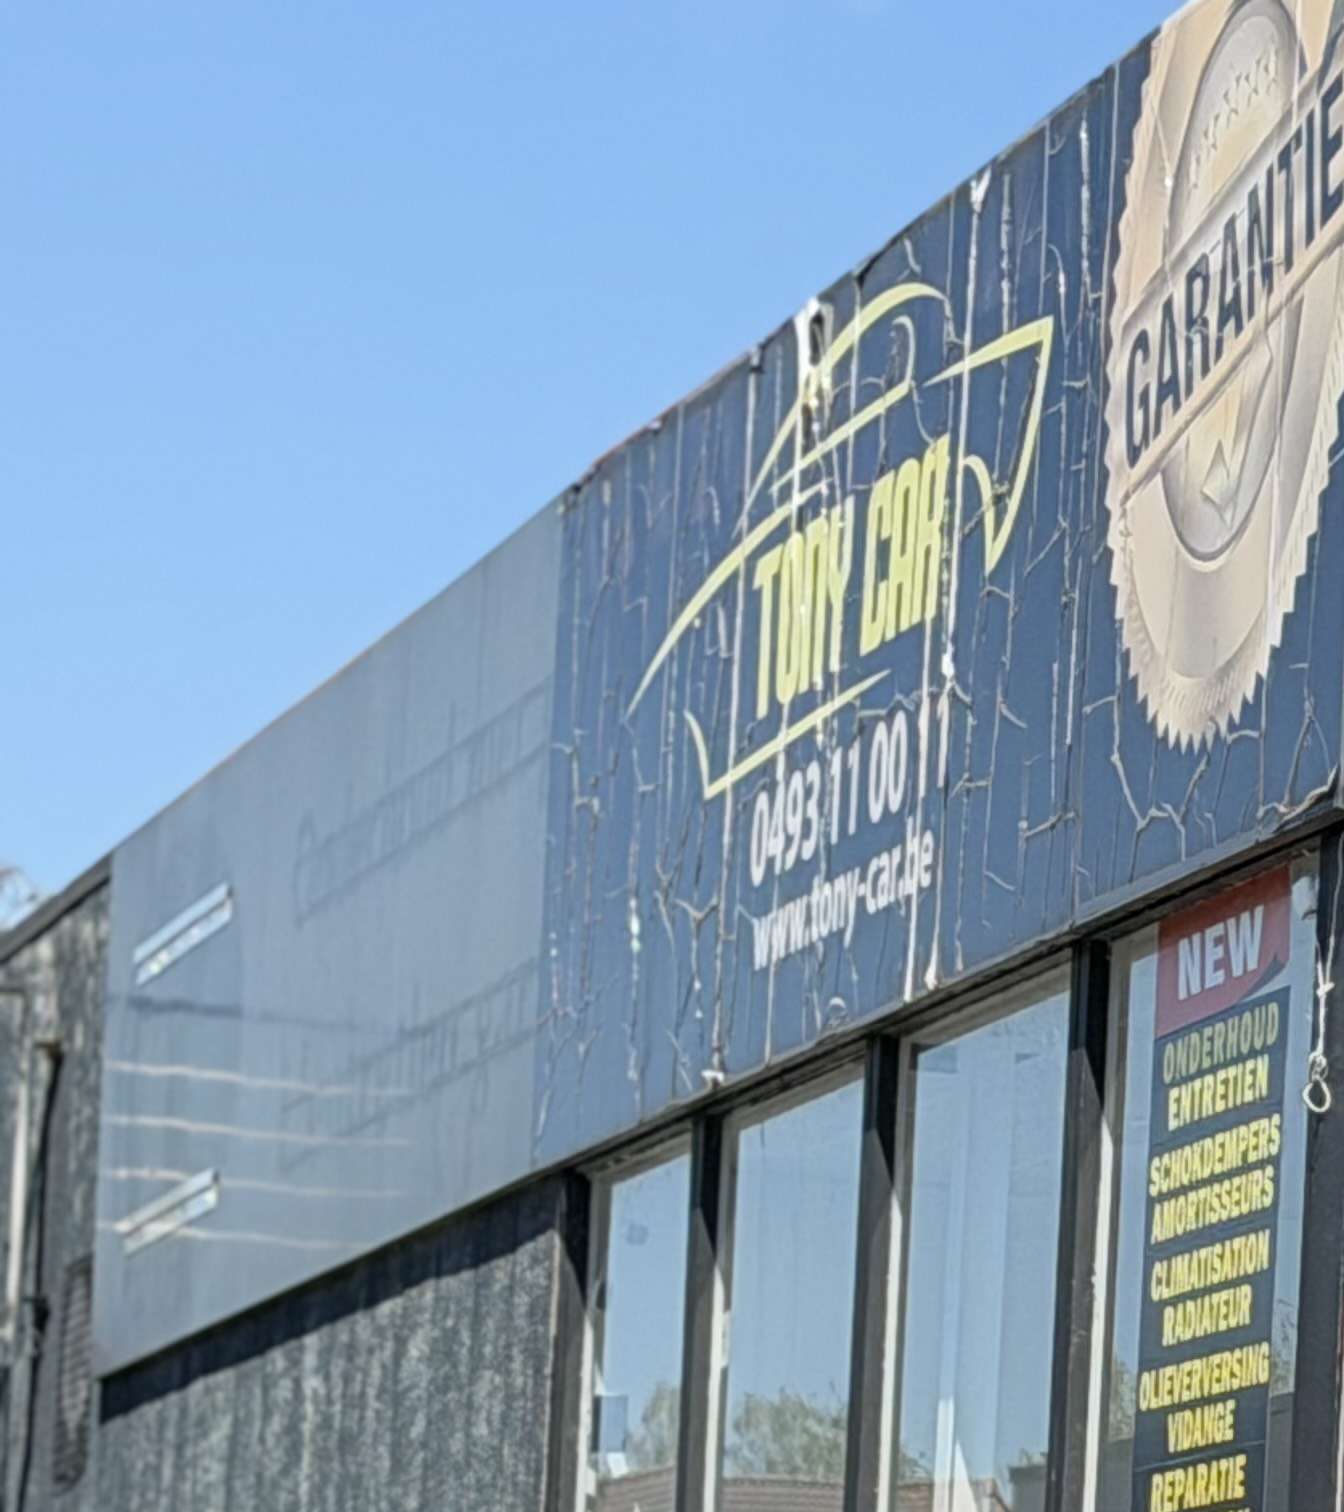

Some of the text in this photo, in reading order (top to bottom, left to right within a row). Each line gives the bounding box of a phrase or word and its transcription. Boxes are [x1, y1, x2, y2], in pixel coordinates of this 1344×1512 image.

[752, 438, 951, 720] TONY CAR
[751, 760, 821, 888] 0493
[829, 735, 861, 846] 11
[867, 709, 907, 825] 00
[752, 816, 934, 972] www.tony-car.be
[1178, 904, 1265, 1001] NEW
[1162, 1001, 1280, 1085] ONDERHOUD
[1168, 1053, 1270, 1132] ENTRETIEN
[1149, 1113, 1281, 1198] SCHOKDEMPERS
[1151, 1165, 1275, 1246] AMORTISSEURS
[1151, 1229, 1271, 1302] CLIMATISATION
[1162, 1283, 1252, 1348] RADIATEUR
[1139, 1341, 1270, 1412] OLIEVERVERSING
[1167, 1399, 1236, 1454] VIDANGE
